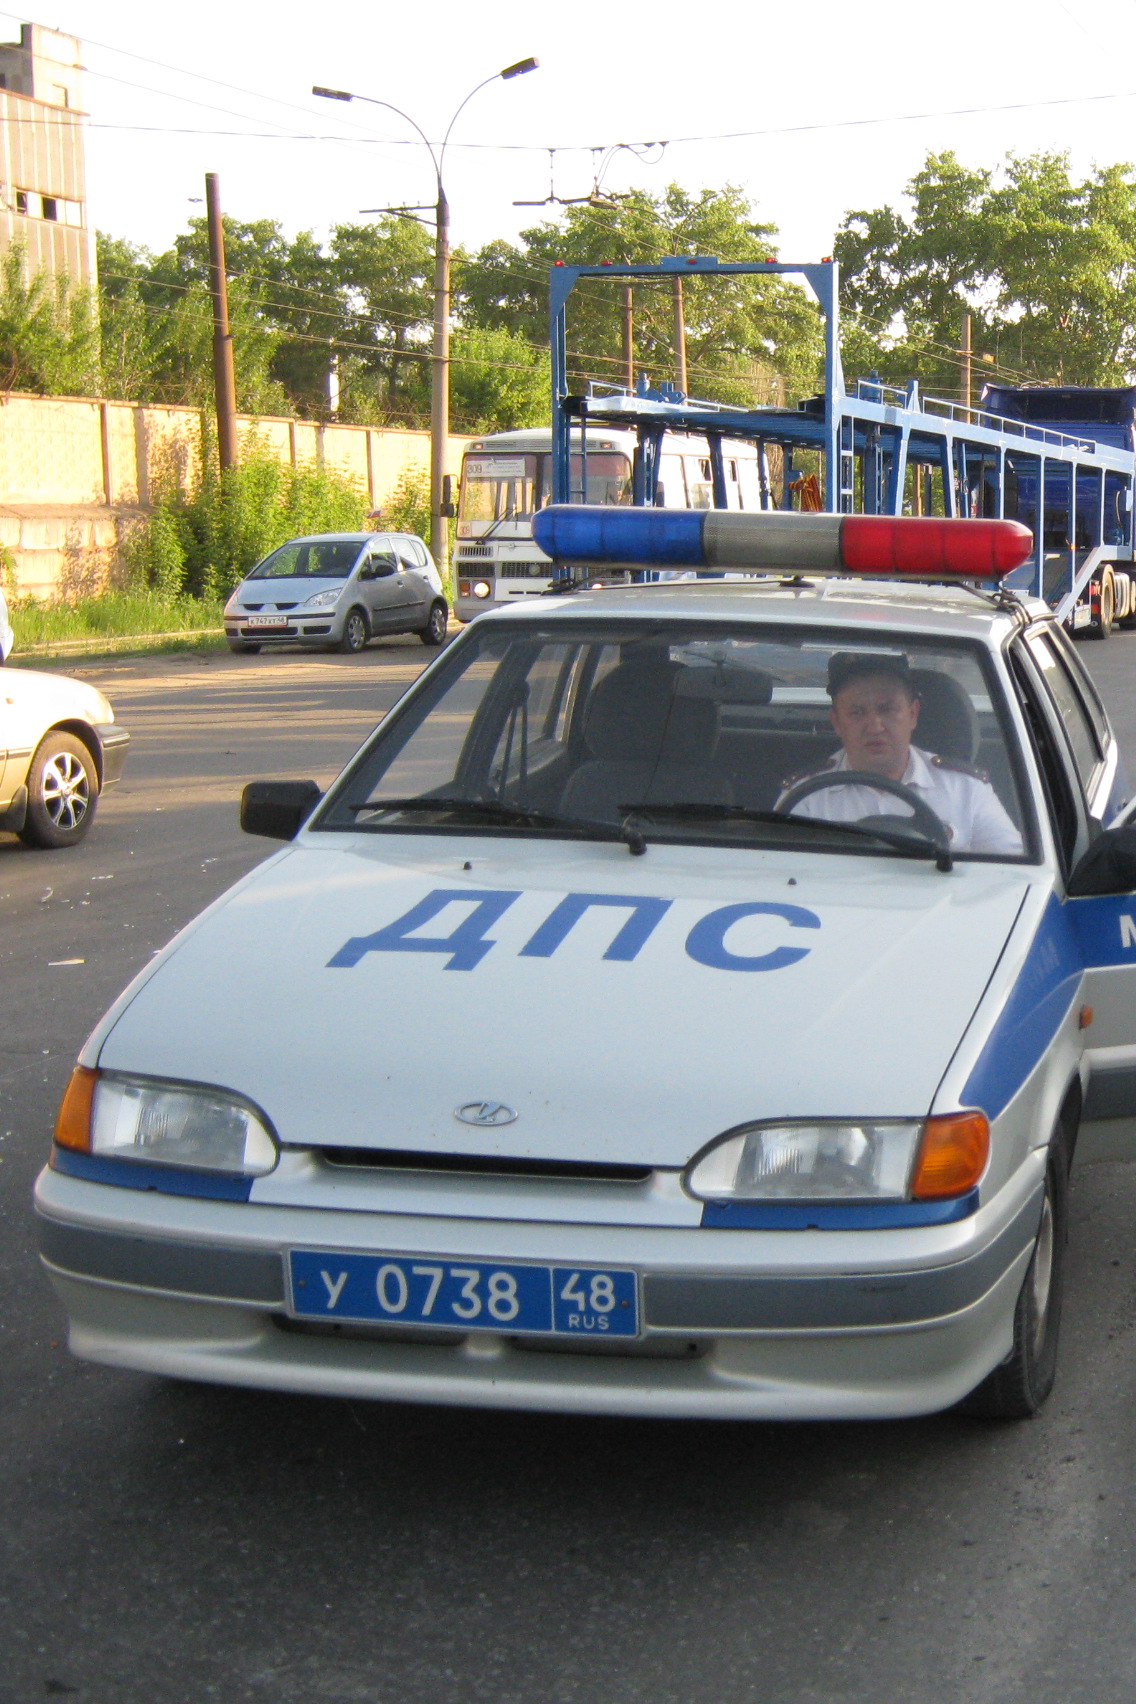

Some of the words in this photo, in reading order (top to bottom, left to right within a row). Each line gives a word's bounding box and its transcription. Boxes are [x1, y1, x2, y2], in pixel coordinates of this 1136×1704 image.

[325, 889, 821, 973] ДПС
[375, 1263, 520, 1321] 0738
[560, 1273, 617, 1314] 48
[567, 1314, 610, 1331] RUS
